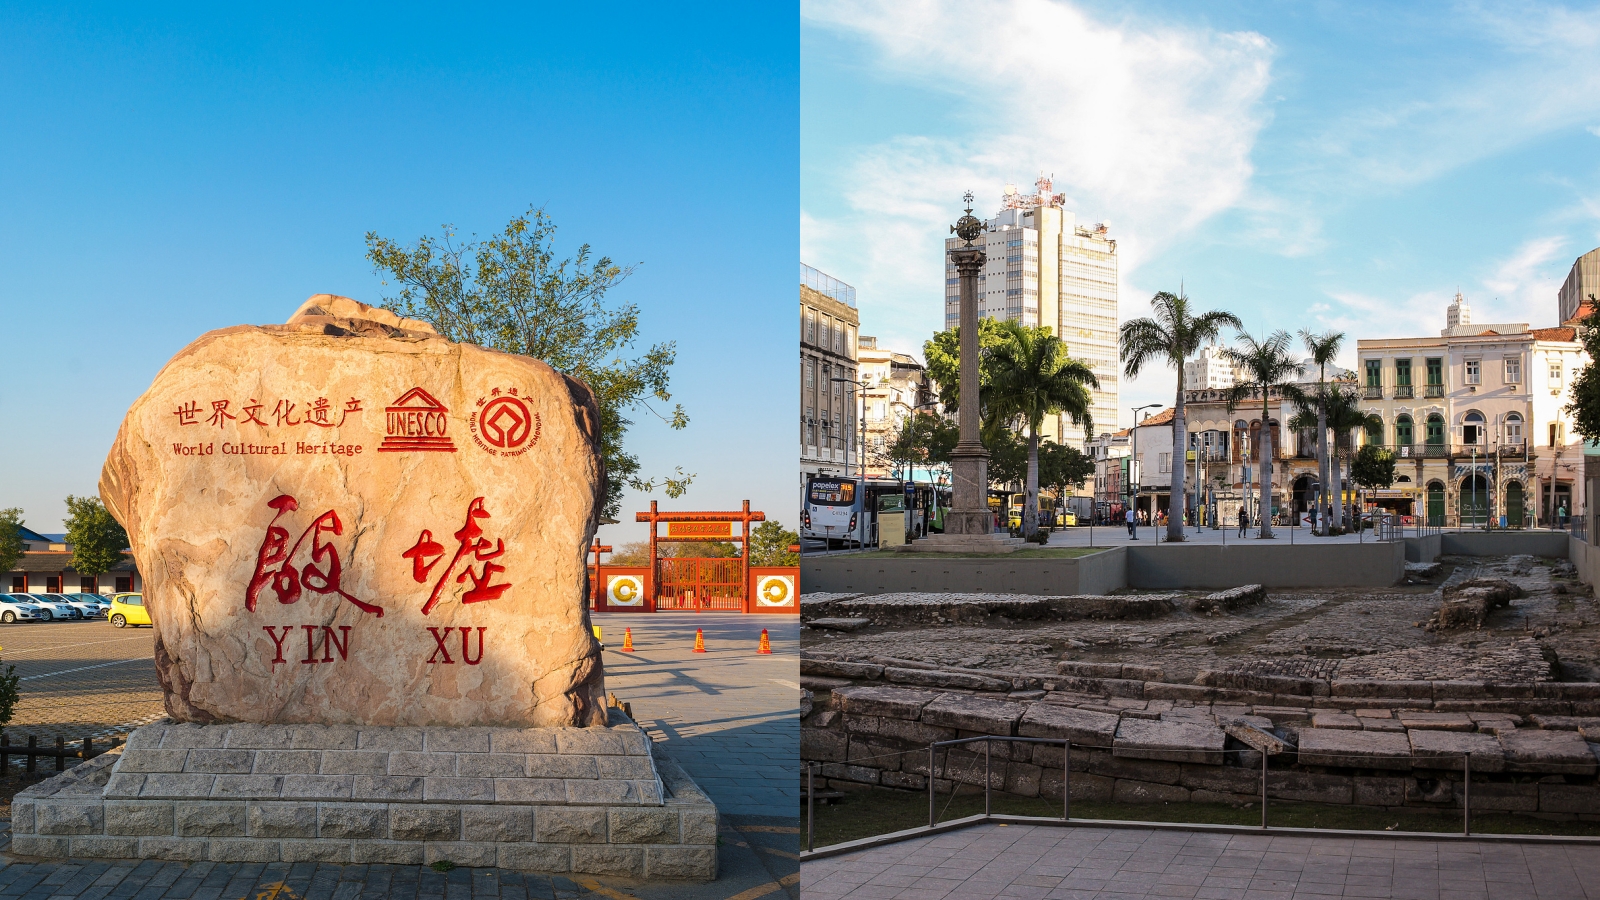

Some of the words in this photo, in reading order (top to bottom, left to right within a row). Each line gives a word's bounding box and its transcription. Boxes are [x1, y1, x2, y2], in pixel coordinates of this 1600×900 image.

[173, 397, 363, 430] 世界文化遗产
[386, 411, 447, 437] UNESCO
[173, 443, 213, 456] World
[221, 442, 288, 455] Cultural
[296, 442, 362, 457] Heritage
[473, 434, 497, 456] HERITAGE
[262, 625, 352, 664] YIN
[426, 626, 487, 665] XU
